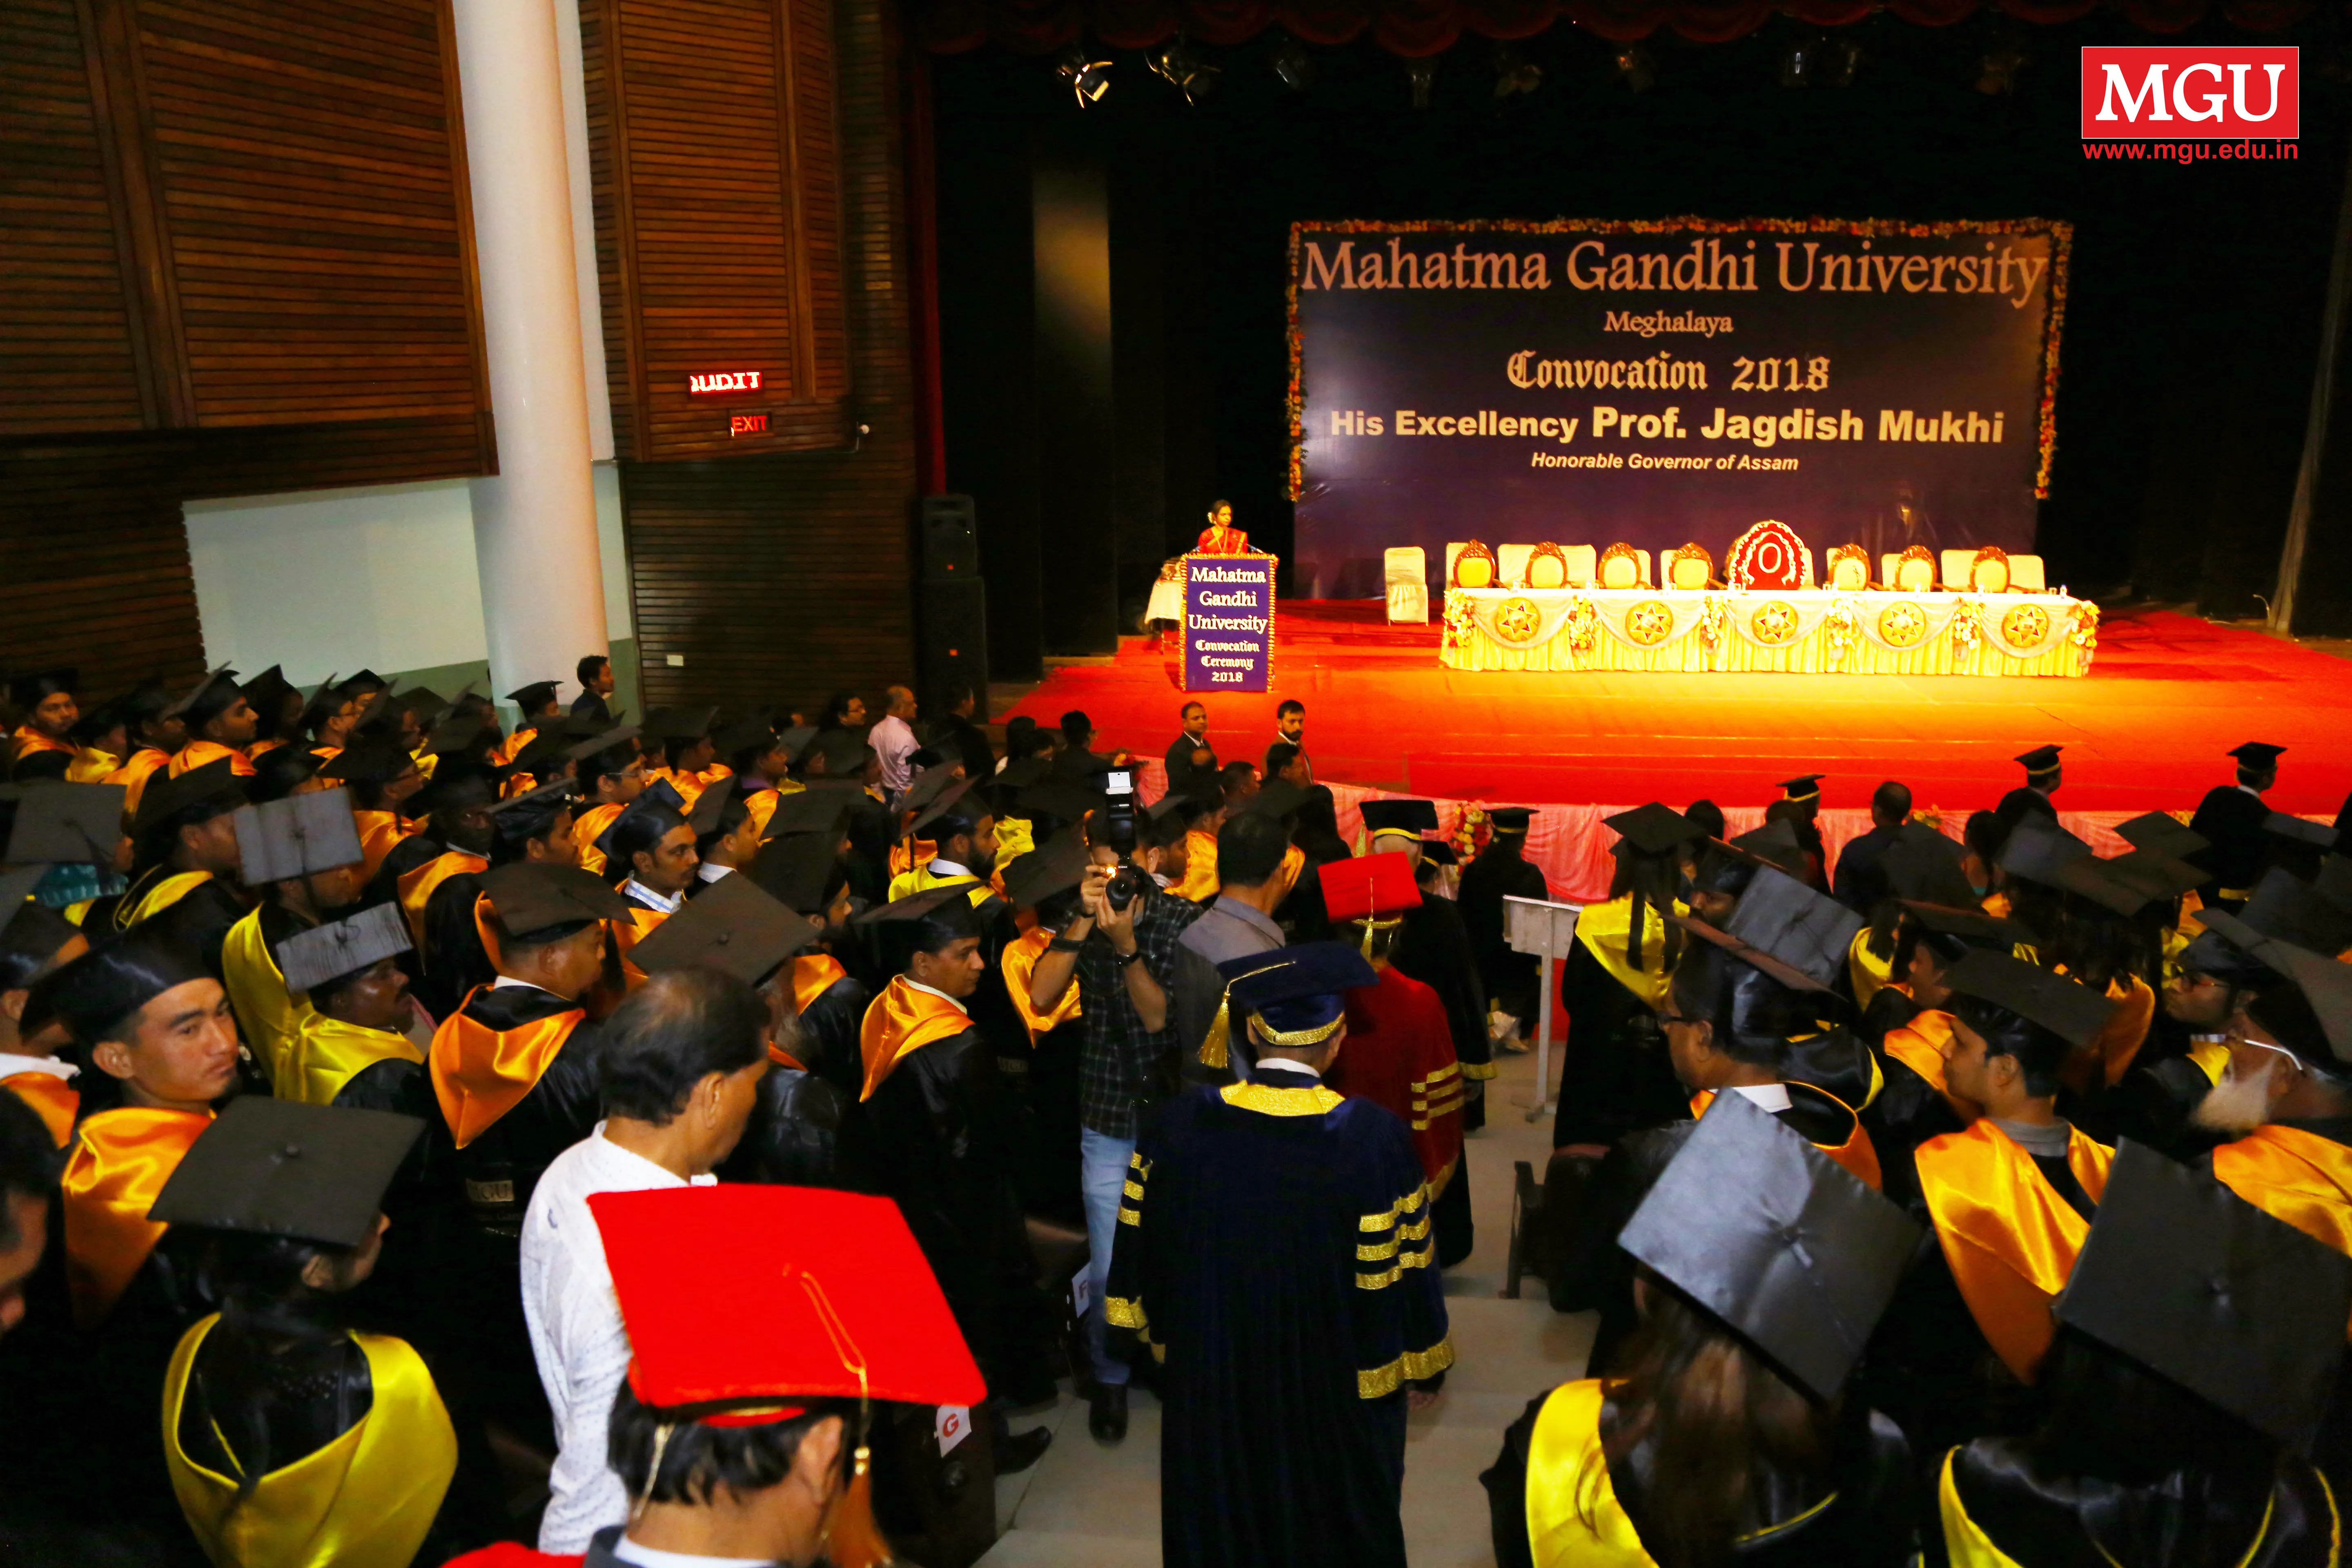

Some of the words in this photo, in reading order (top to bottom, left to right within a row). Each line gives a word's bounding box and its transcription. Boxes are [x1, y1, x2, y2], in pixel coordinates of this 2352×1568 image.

[1302, 238, 1551, 290] Mahatma
[1567, 239, 1758, 291] Gandhi
[1775, 241, 2047, 309] University
[1604, 310, 1734, 338] Meghalaya
[1506, 350, 1708, 390] Convocation
[1731, 356, 1831, 392] 2018
[731, 416, 767, 432] EXIT
[1331, 410, 1385, 437] His
[1395, 410, 1579, 444] Excellency
[1592, 406, 1686, 439] Prof.
[1701, 407, 1863, 447] Jagdish
[1878, 410, 2004, 443] Mukhi
[1531, 452, 1624, 469] Honorable
[1628, 453, 1713, 470] Governor
[1715, 454, 1737, 470] of
[1737, 454, 1799, 471] Assam
[1190, 566, 1267, 583] Mahatma
[1199, 590, 1258, 607] Gandhi
[1188, 614, 1268, 635] University
[1195, 639, 1260, 652] Convocation
[1200, 655, 1254, 671] Ceremony
[1211, 671, 1243, 682] 2018
[942, 1413, 959, 1437] G
